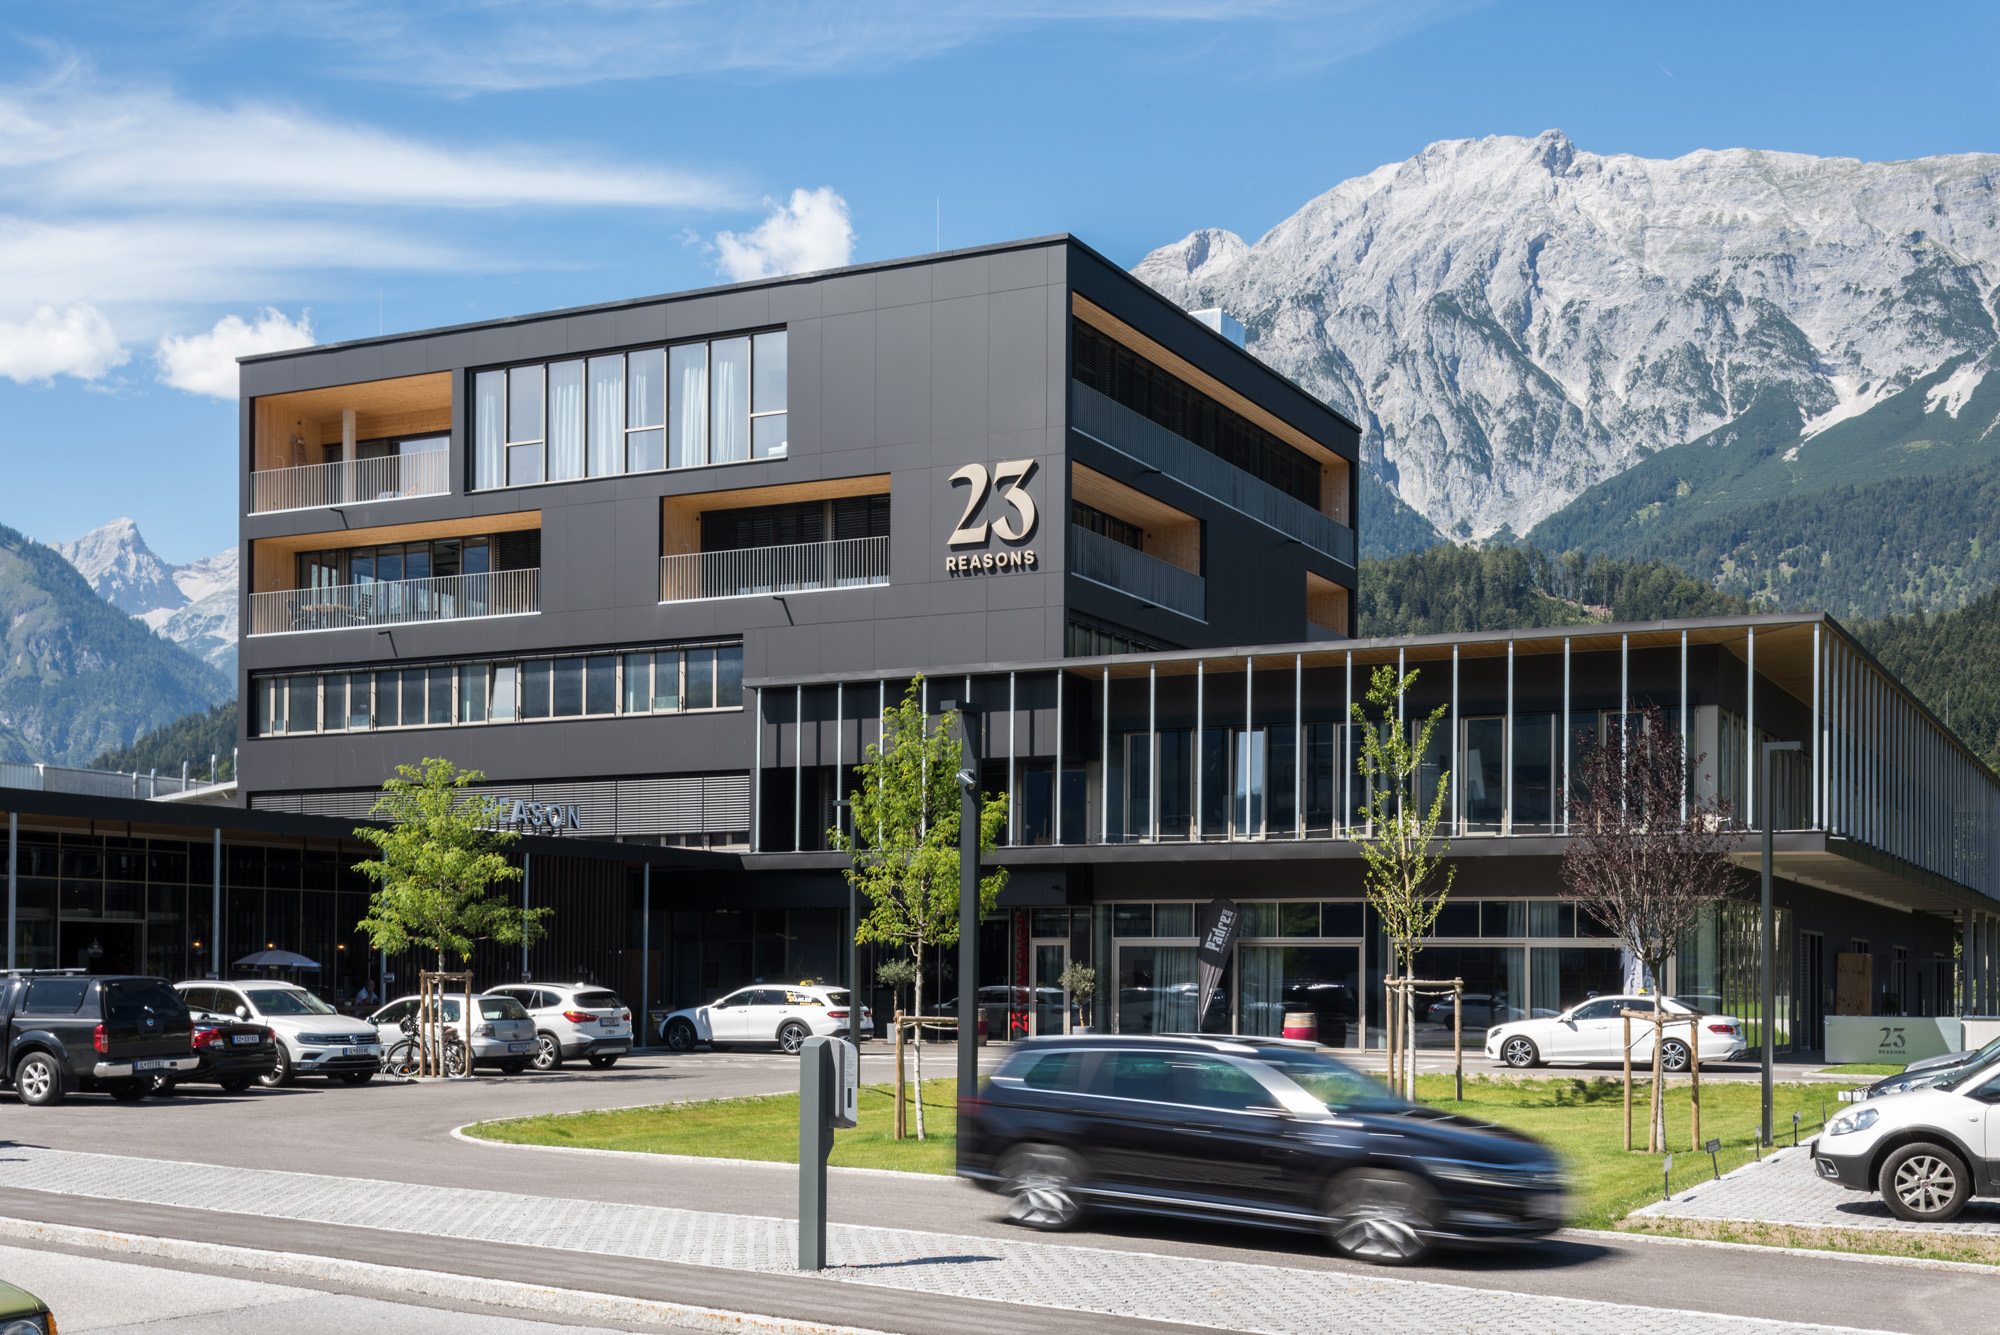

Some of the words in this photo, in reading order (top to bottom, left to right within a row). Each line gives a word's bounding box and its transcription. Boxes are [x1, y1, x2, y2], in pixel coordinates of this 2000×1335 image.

[947, 458, 1036, 546] 23
[945, 549, 1036, 572] REASONS
[1016, 914, 1029, 1006] WINESHOP
[1879, 1026, 1906, 1048] 23
